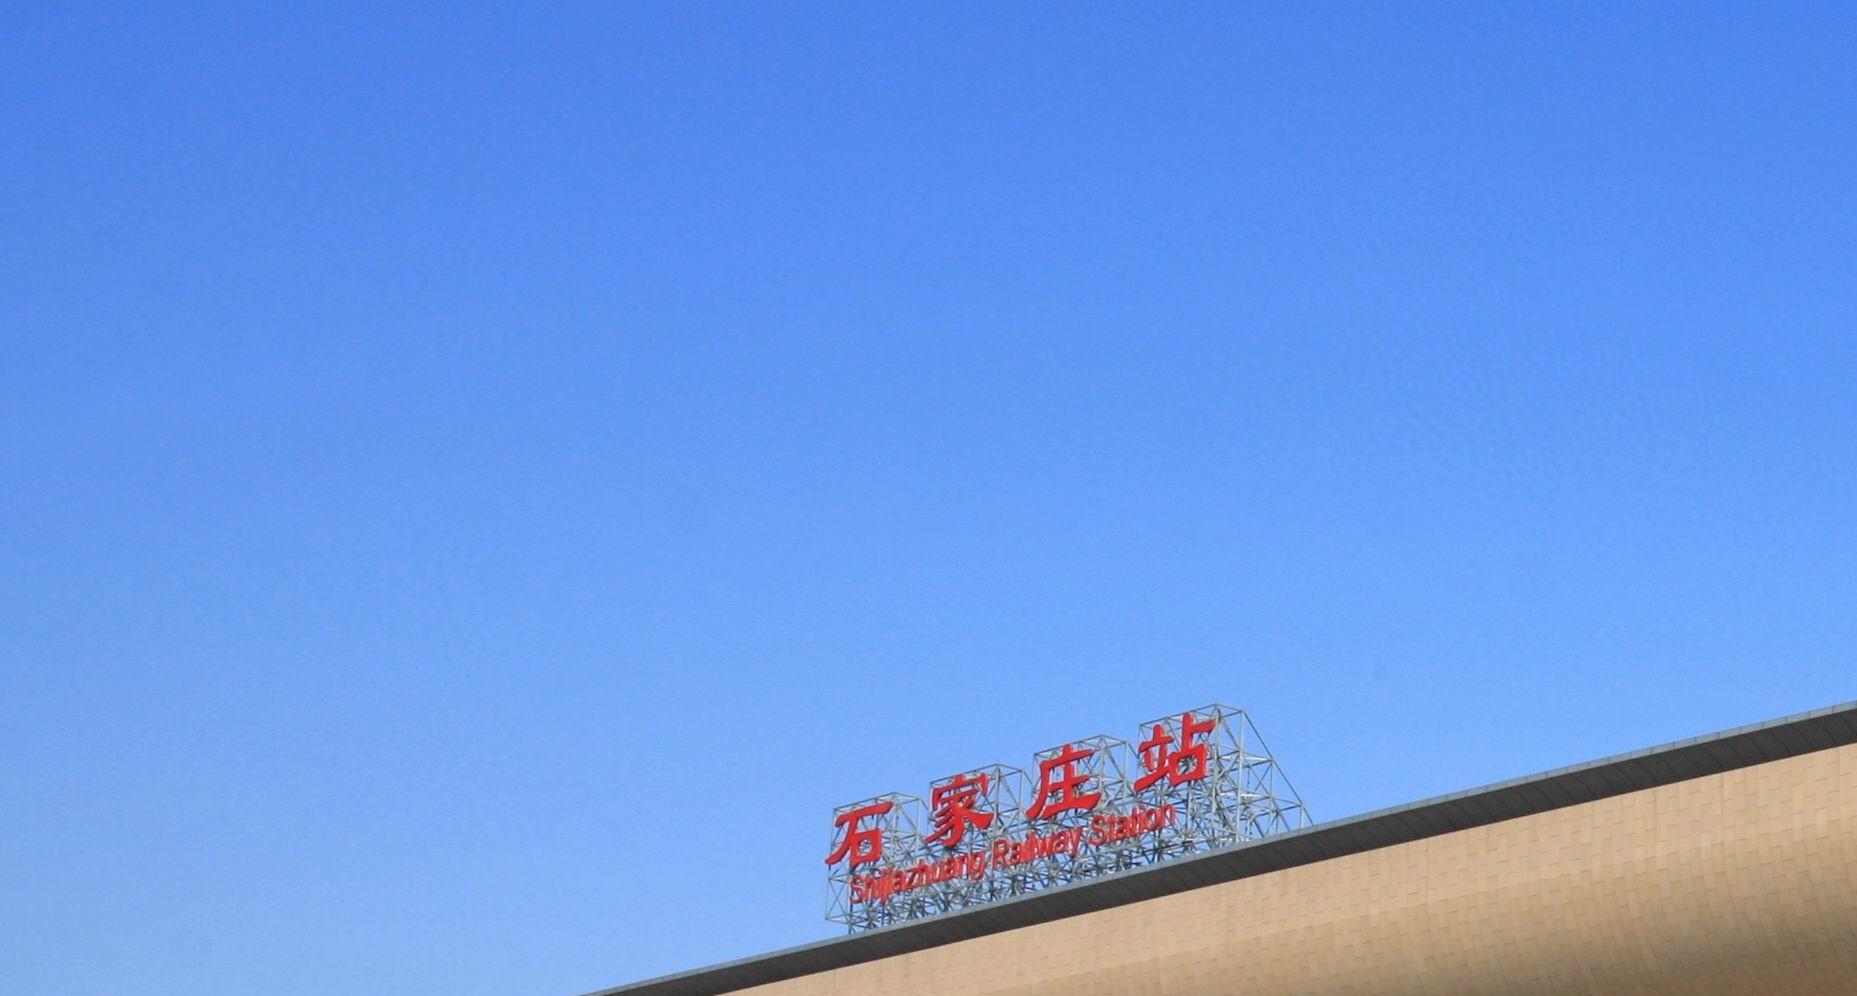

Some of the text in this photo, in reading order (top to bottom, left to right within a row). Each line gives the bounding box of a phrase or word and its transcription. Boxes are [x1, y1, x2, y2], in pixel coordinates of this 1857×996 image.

[826, 712, 1216, 868] 石家庄站
[849, 802, 1175, 905] Shijiazhuang Railway Station
